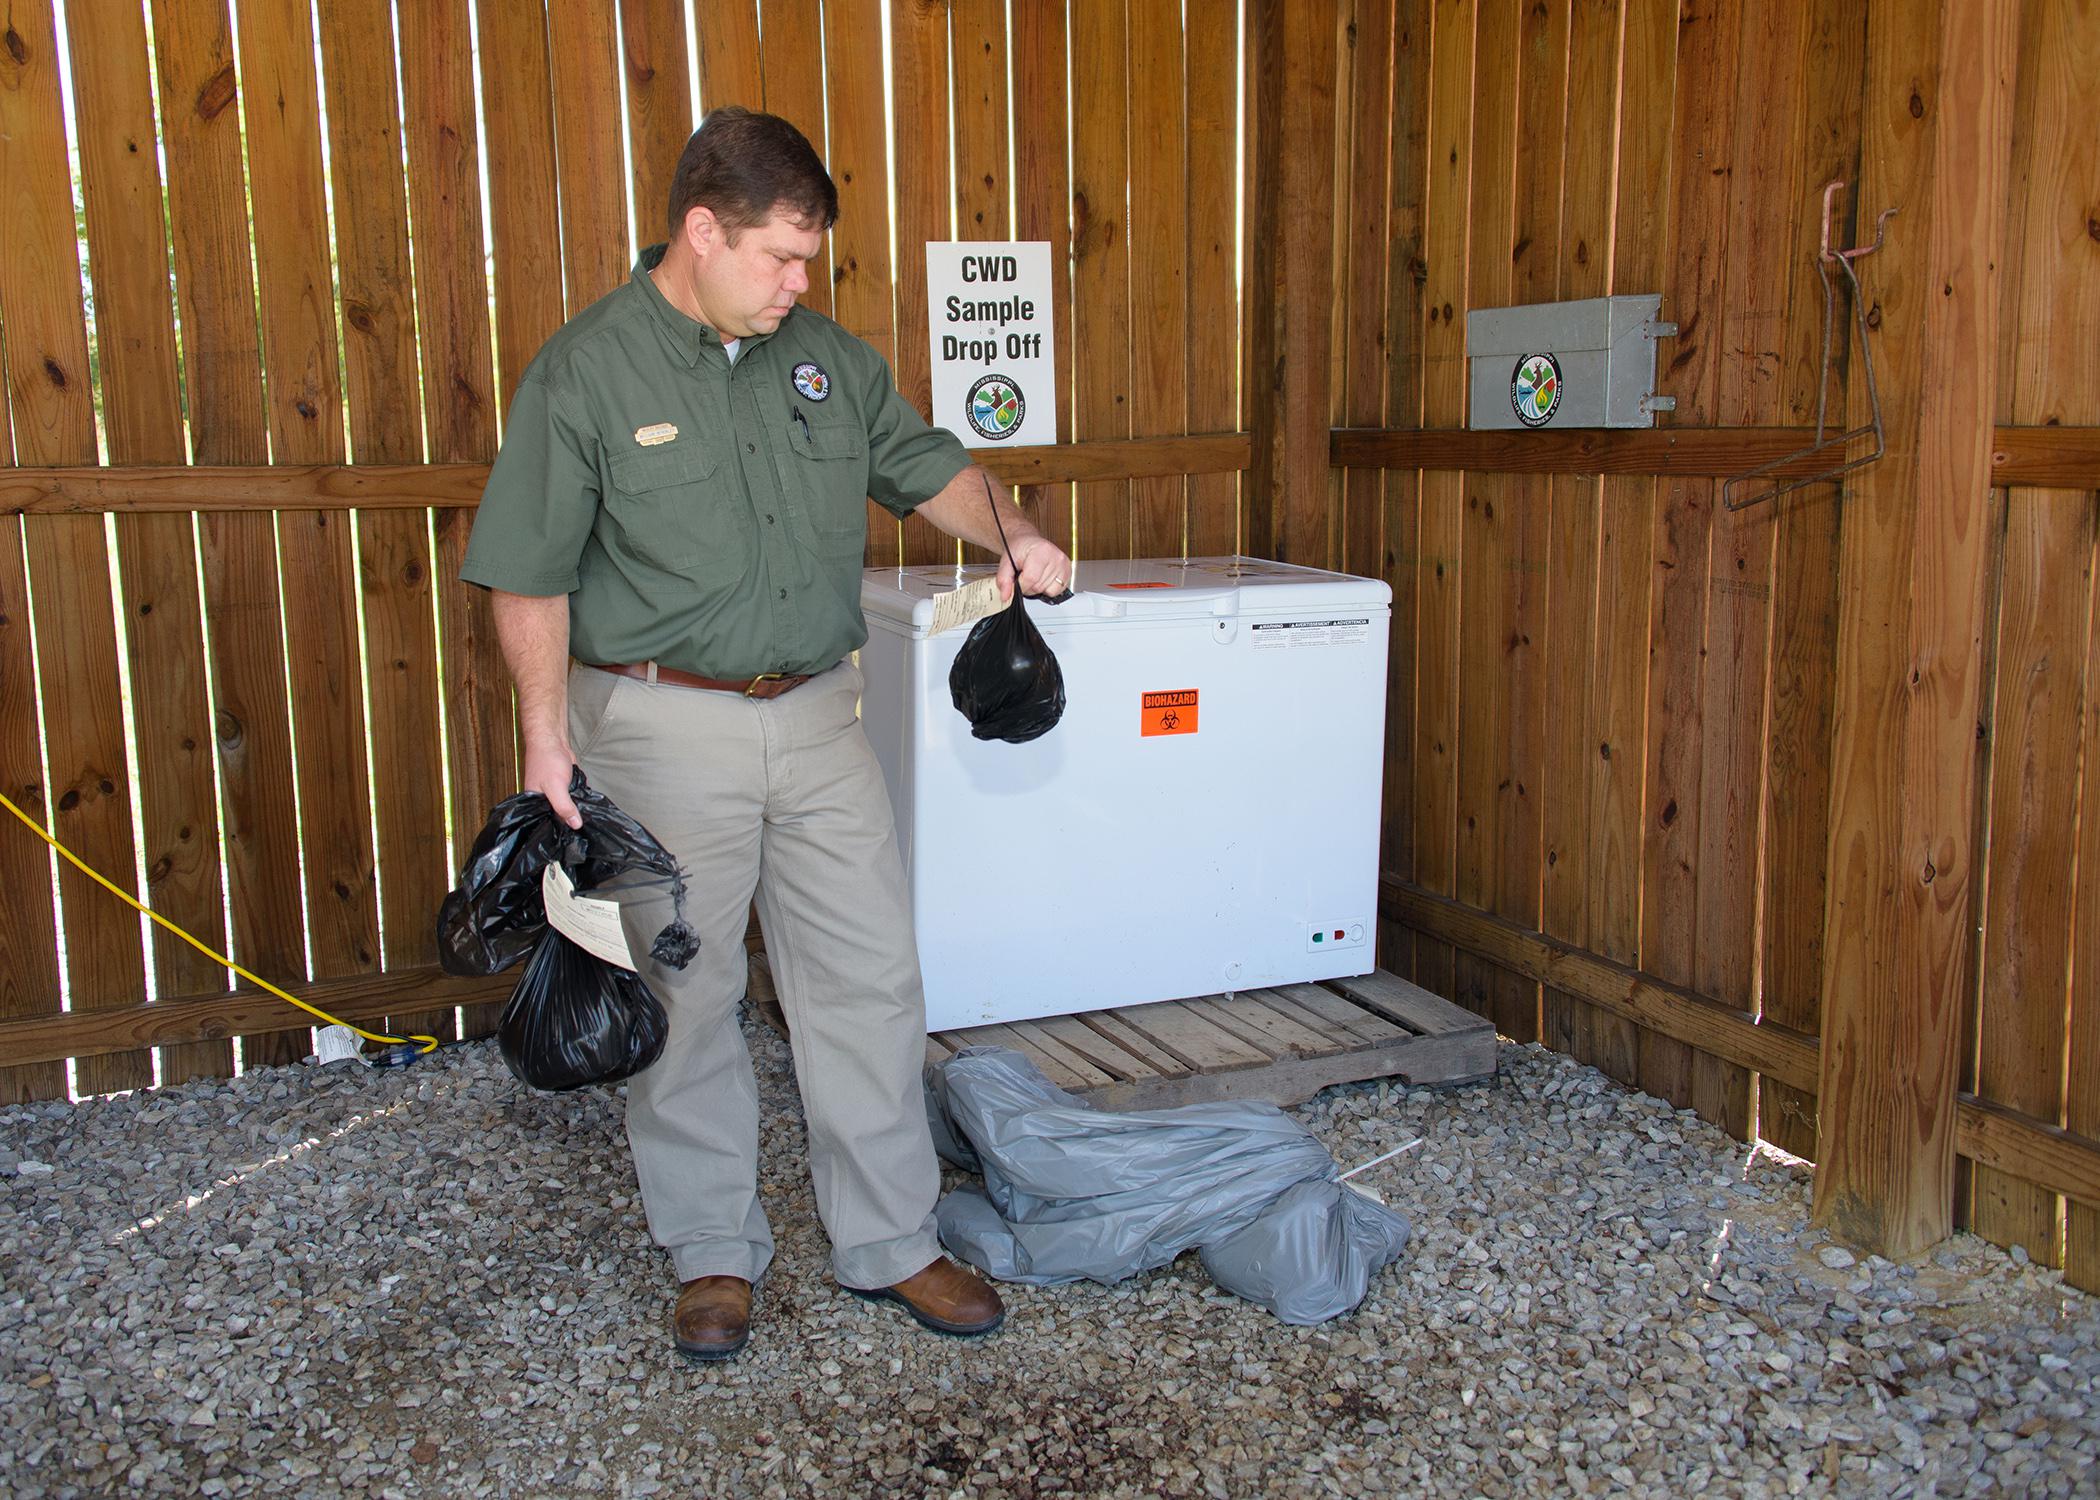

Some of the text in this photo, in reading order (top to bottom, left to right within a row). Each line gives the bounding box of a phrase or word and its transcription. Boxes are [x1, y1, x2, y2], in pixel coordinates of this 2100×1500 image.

[961, 255, 1017, 282] CWD
[946, 295, 1034, 327] Sample
[942, 333, 1041, 365] Drop Off
[974, 375, 1014, 390] MISSISSIPPI
[1554, 380, 1562, 407] PARKS
[1016, 400, 1025, 424] PARKS
[1145, 692, 1196, 707] BIOHAZARD
